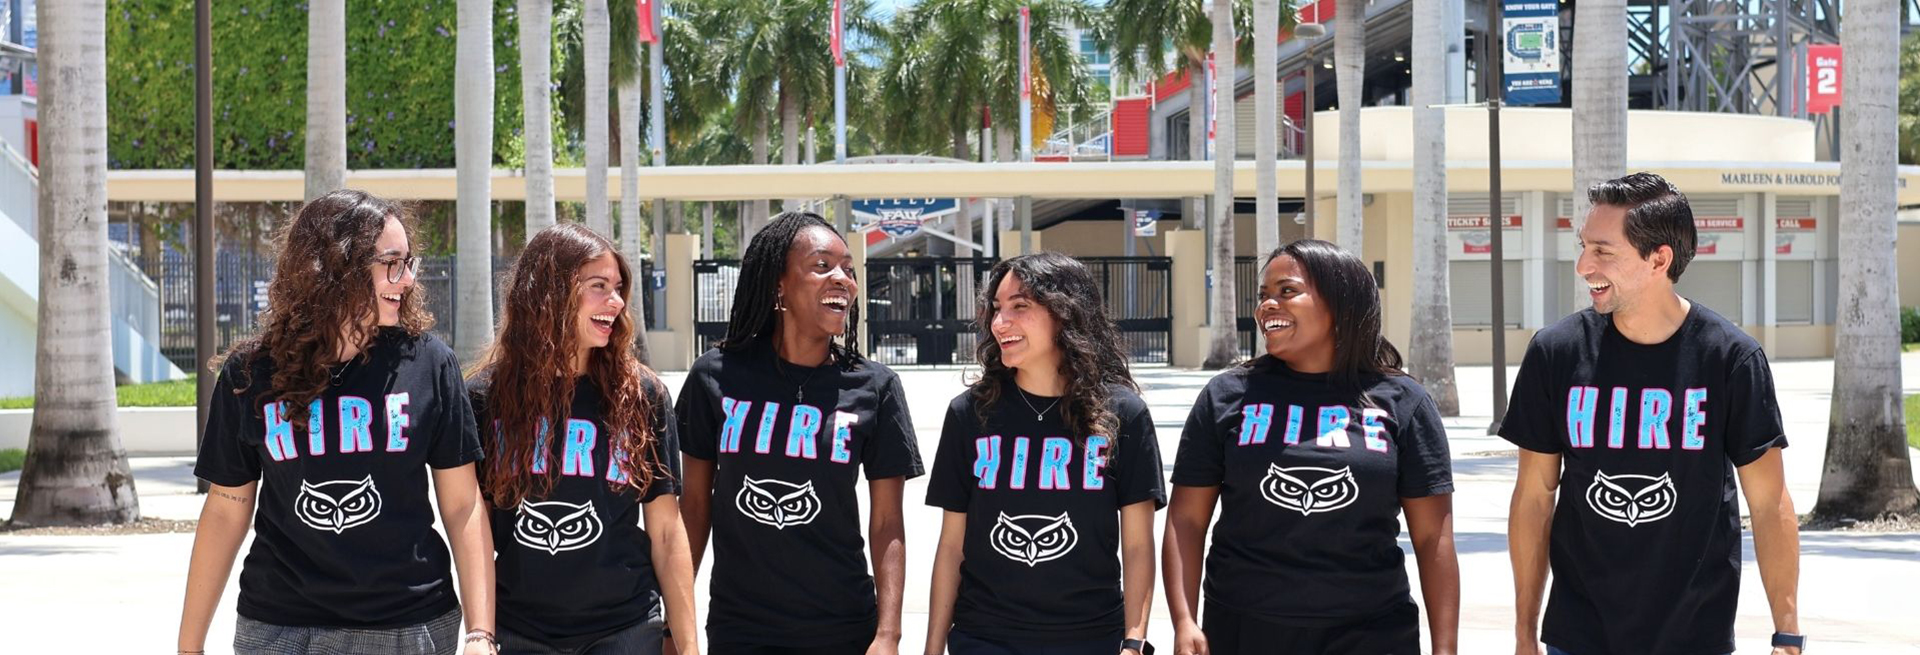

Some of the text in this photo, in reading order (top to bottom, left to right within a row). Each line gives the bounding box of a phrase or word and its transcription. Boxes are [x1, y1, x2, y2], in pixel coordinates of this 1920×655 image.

[1816, 56, 1838, 67] Gate
[1817, 67, 1837, 94] 2
[1721, 173, 1773, 184] MARLEEN
[1775, 174, 1783, 184] &
[1785, 174, 1825, 185] HAROLD
[881, 210, 918, 221] FAU
[1448, 217, 1512, 227] TICKET SES
[1707, 219, 1737, 227] SERVICE
[1780, 219, 1800, 228] CALL
[264, 392, 411, 461] HIRE
[1566, 386, 1709, 449] HIRE
[720, 397, 859, 464] HIRE
[1238, 403, 1389, 453] HIRE
[973, 435, 1109, 490] HIRE
